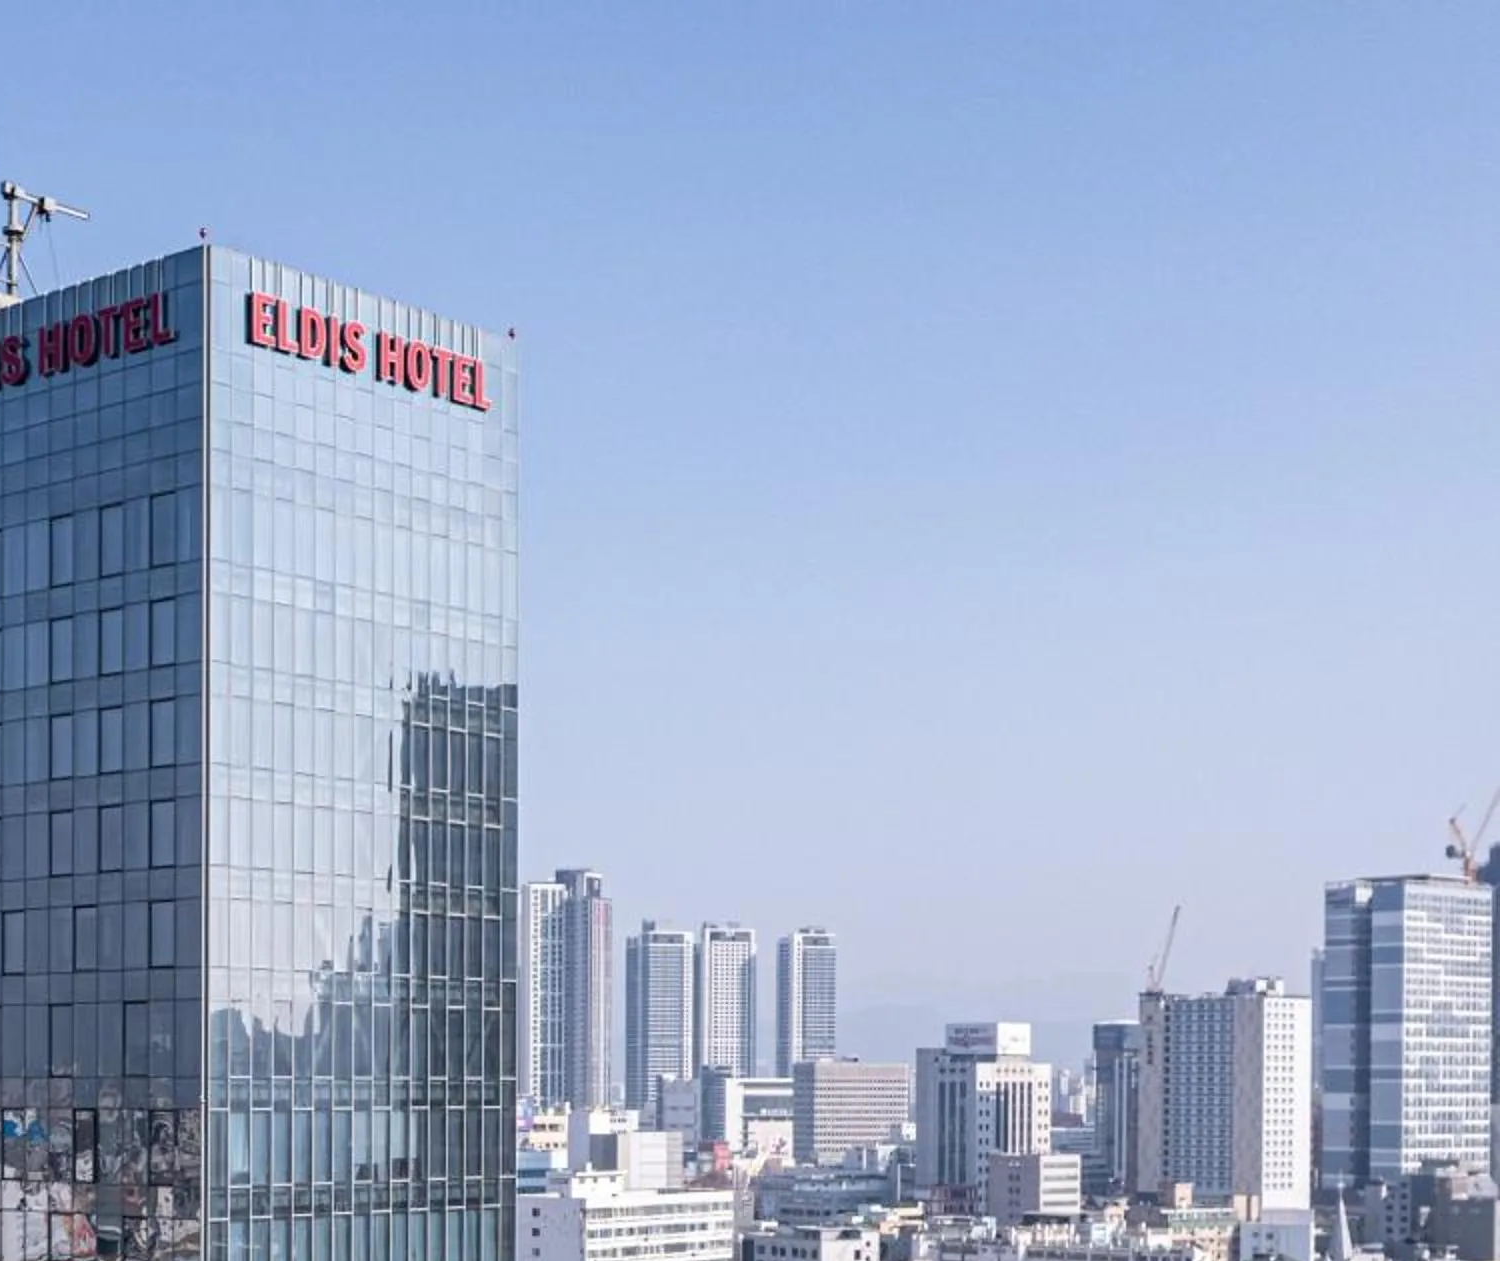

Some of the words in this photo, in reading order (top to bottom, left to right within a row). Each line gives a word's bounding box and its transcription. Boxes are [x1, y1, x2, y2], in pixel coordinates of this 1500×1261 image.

[38, 293, 176, 377] HOTEL
[249, 290, 367, 373] ELDIS
[378, 331, 492, 411] HOTEL
